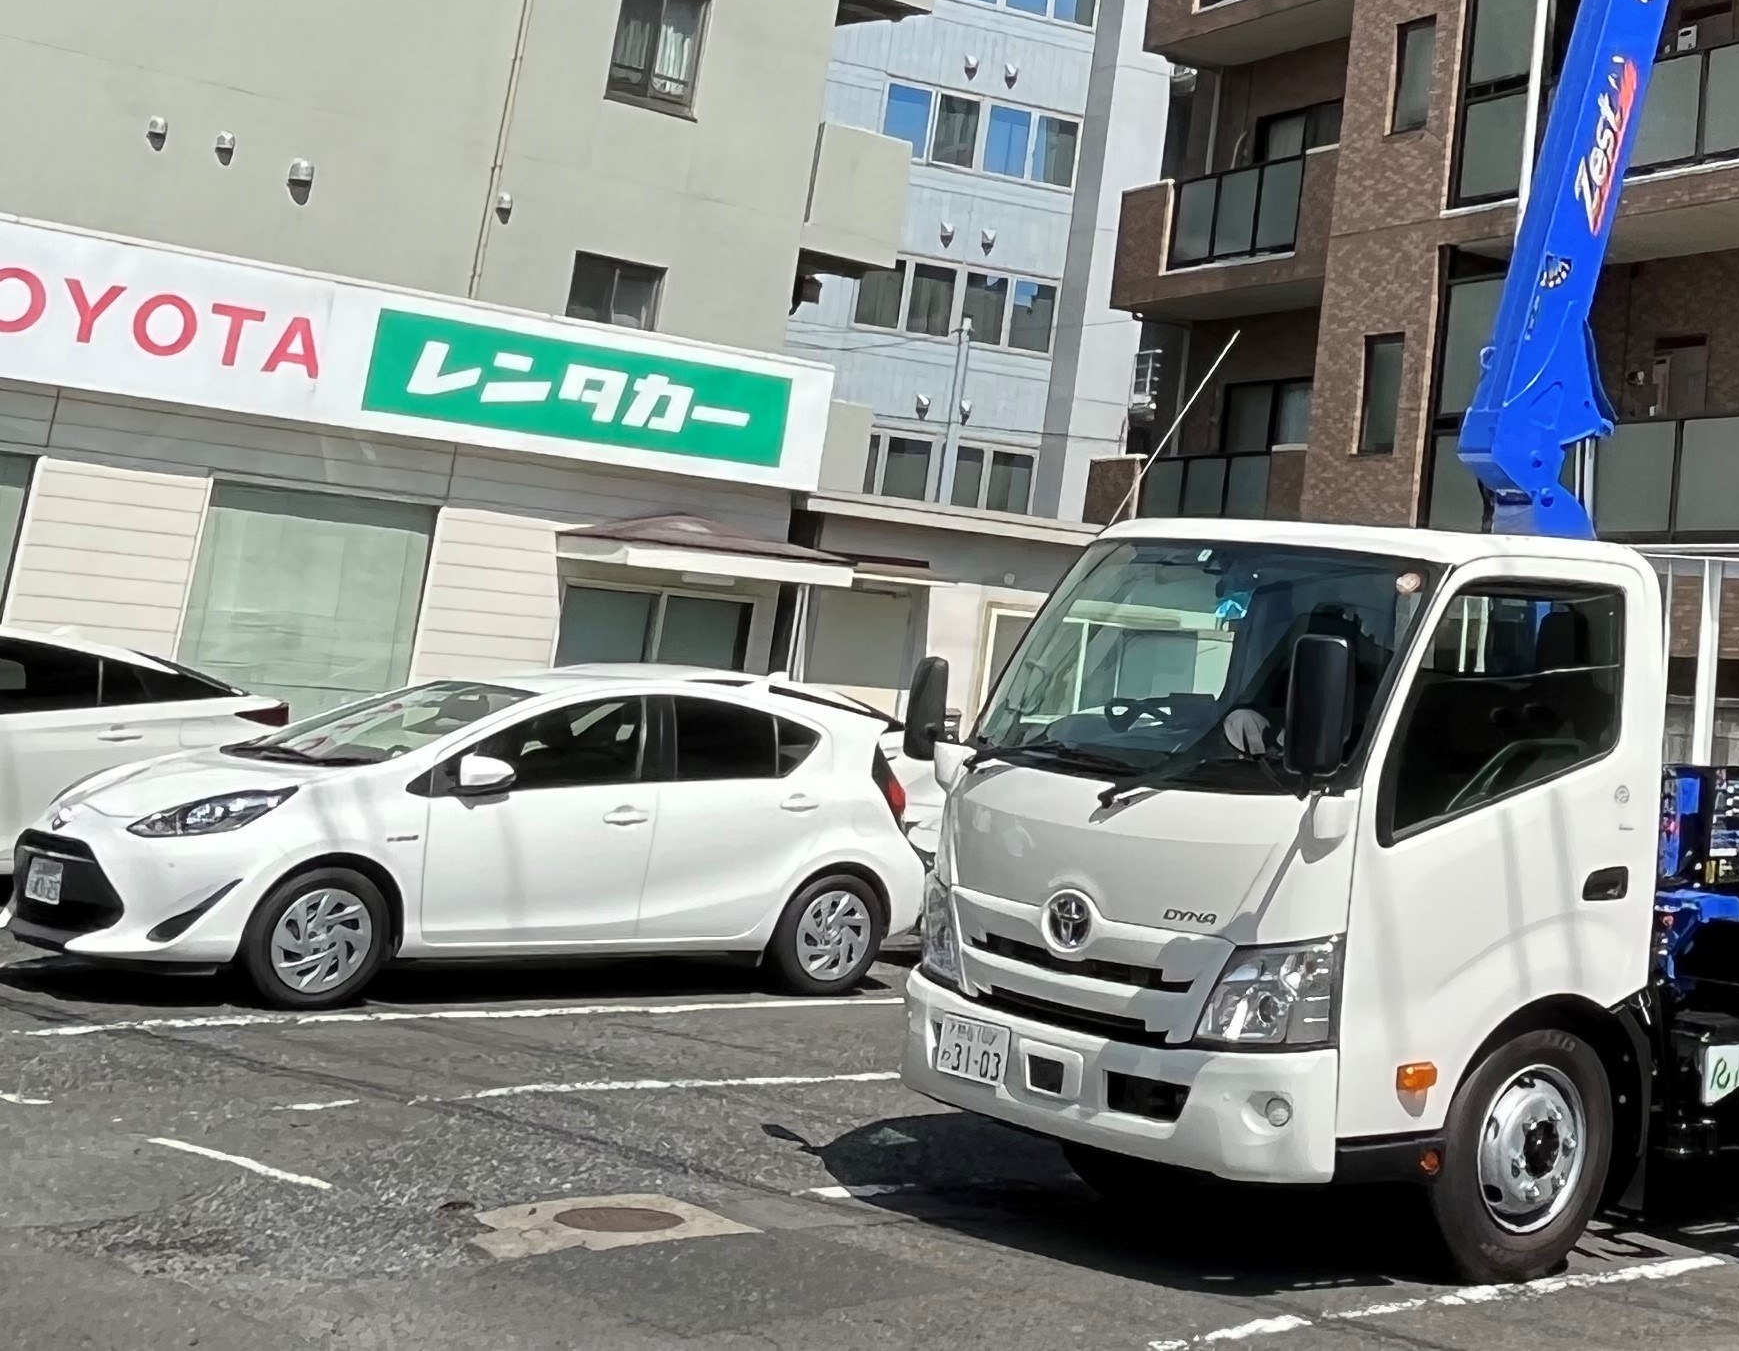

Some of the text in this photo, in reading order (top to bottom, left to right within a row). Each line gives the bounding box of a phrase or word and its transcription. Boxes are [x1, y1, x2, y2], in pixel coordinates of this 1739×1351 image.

[406, 340, 750, 432] レンタカー
[1163, 908, 1217, 925] DYNA
